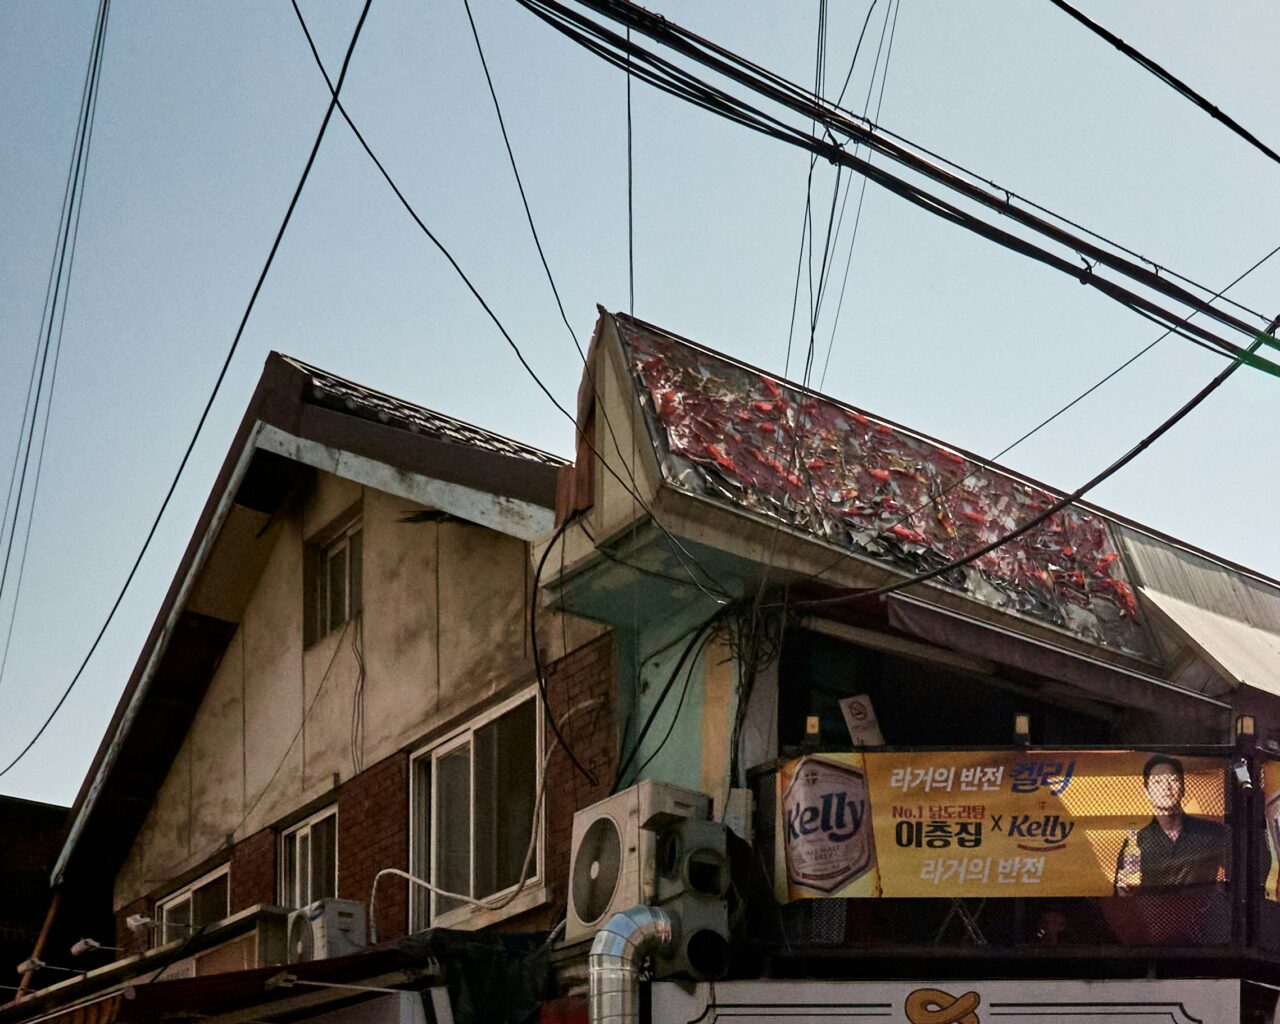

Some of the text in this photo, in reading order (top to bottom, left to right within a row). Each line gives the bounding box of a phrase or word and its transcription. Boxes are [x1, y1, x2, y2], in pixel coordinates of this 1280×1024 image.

[891, 758, 1072, 795] 라거의 반전 켈리
[786, 792, 866, 845] Kelly
[895, 820, 983, 848] 이층집
[1008, 811, 1074, 847] Kelly
[920, 856, 1045, 885] 라거의 반전
